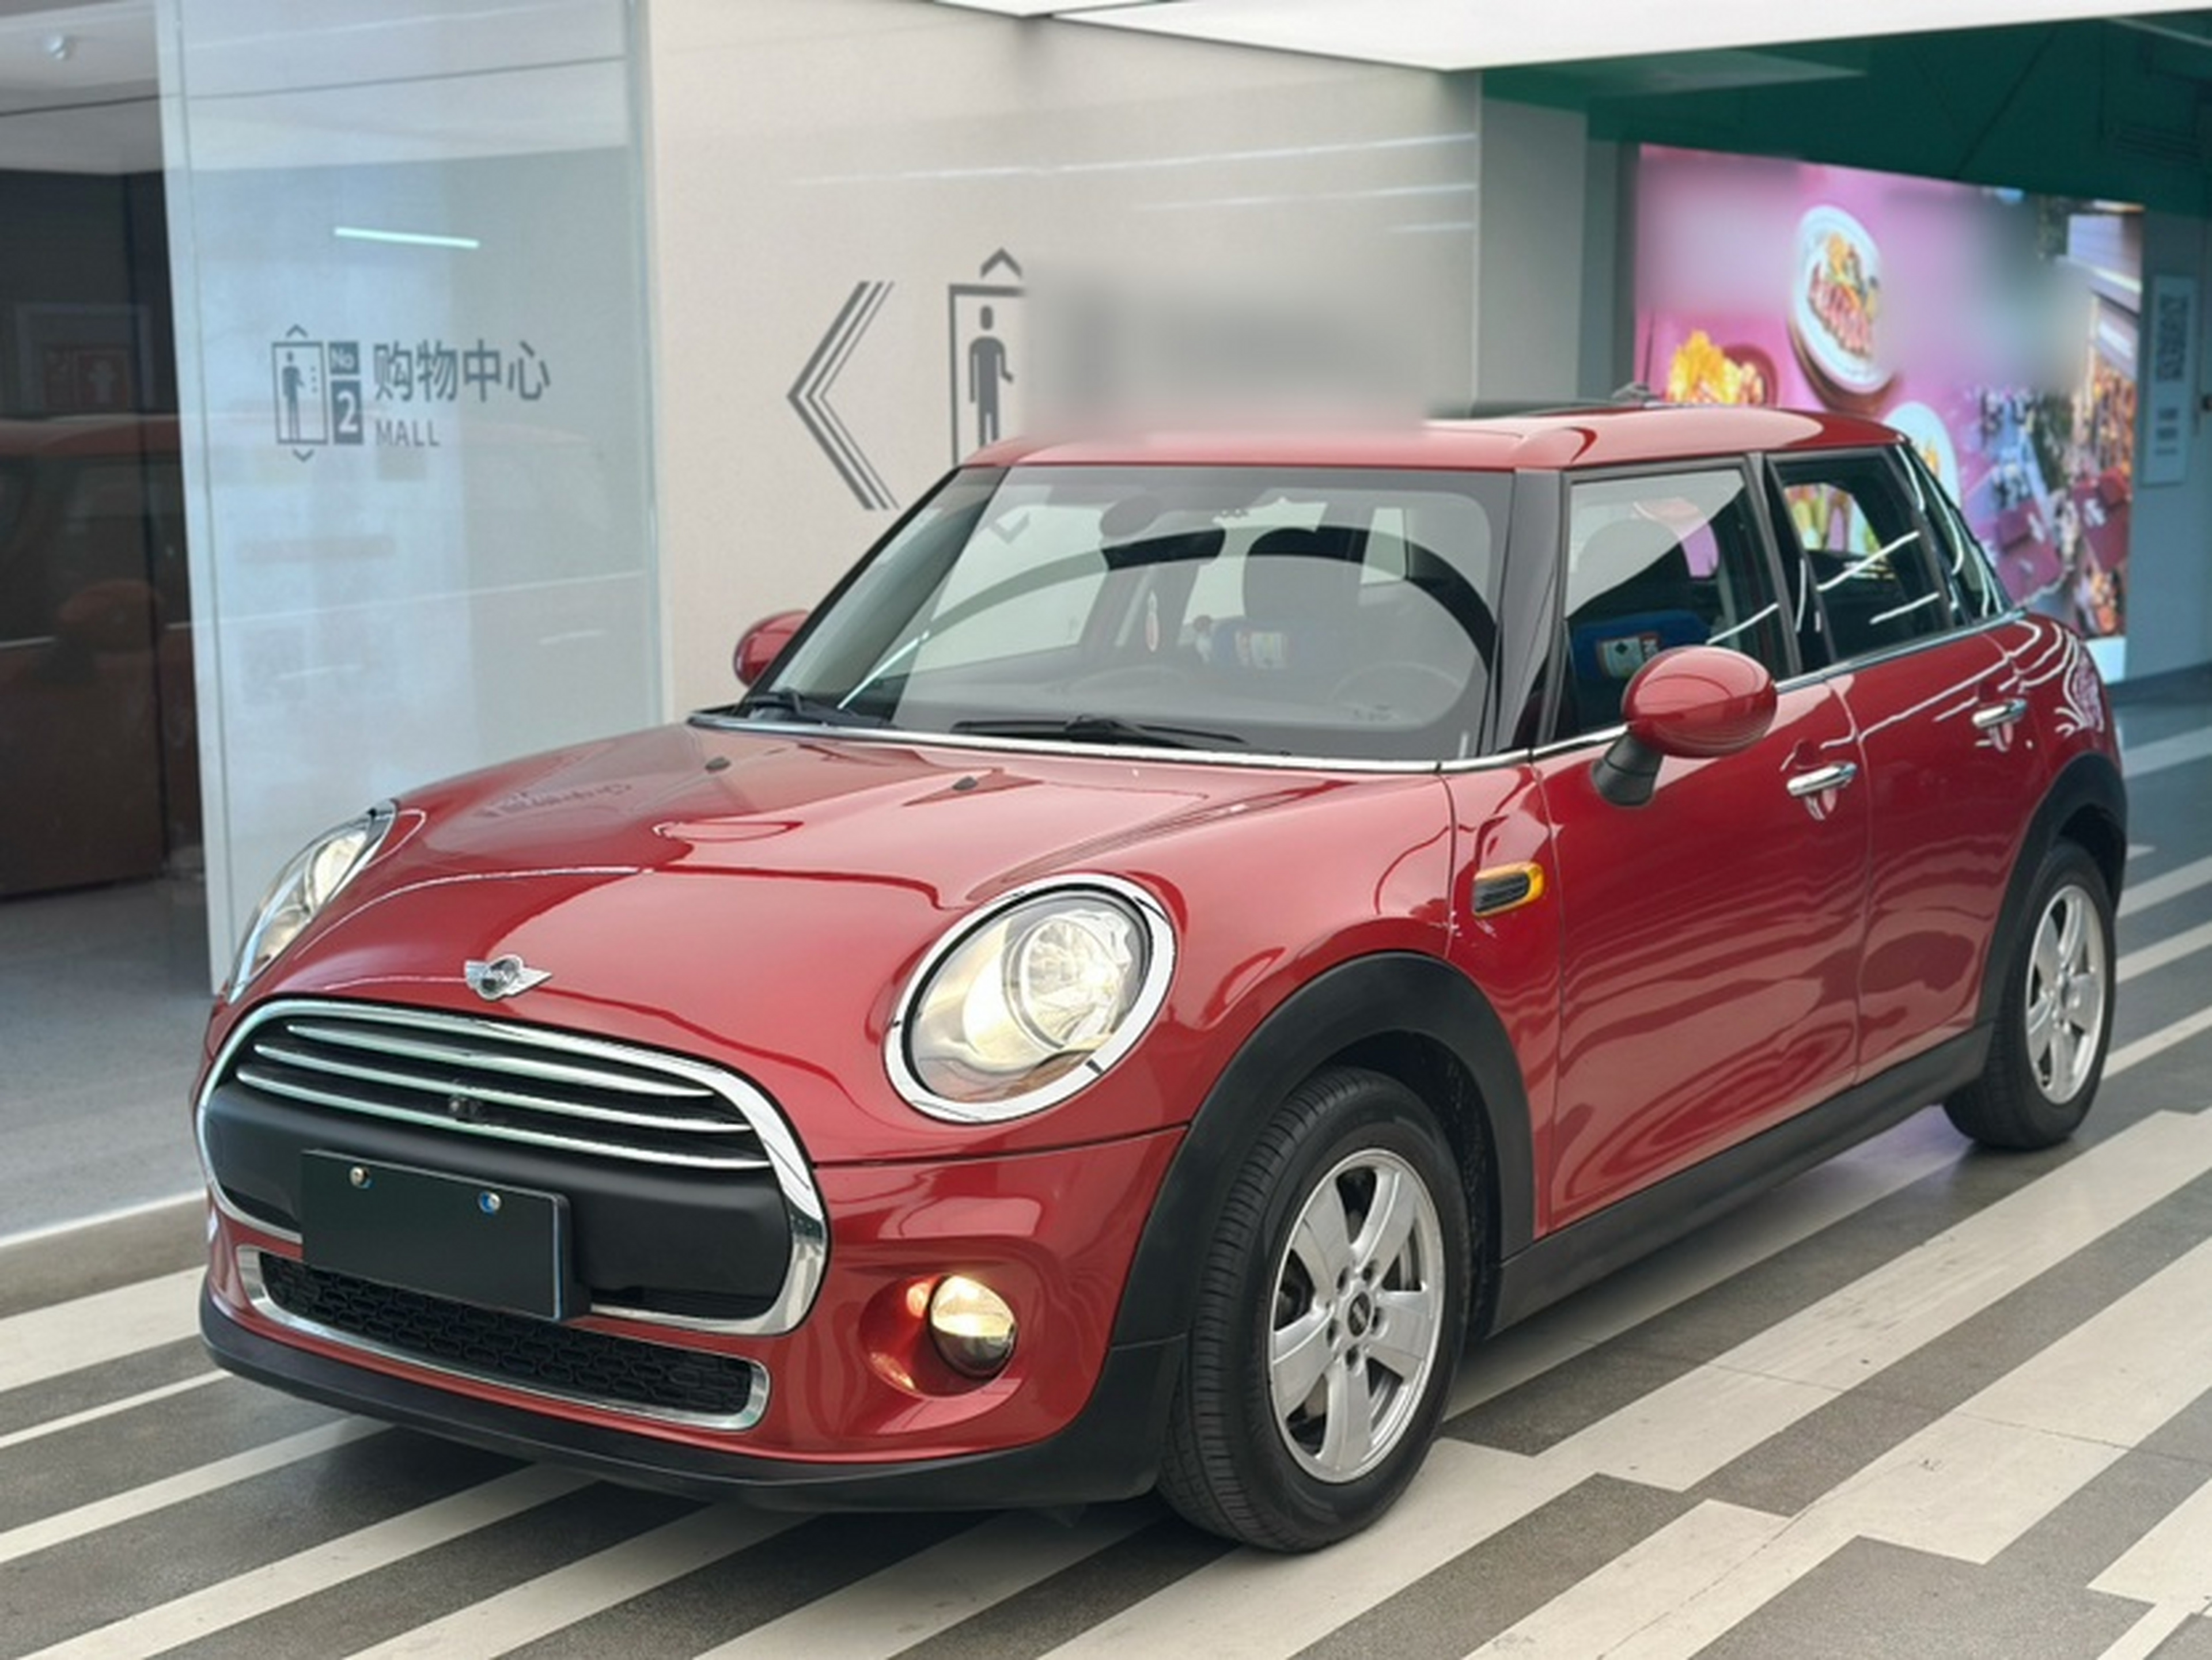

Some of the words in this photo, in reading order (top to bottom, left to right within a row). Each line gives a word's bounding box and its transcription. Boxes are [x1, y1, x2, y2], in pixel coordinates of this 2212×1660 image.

[331, 347, 355, 369] No
[373, 339, 550, 403] 购物中心
[336, 389, 358, 434] 2
[376, 420, 441, 447] MALL
